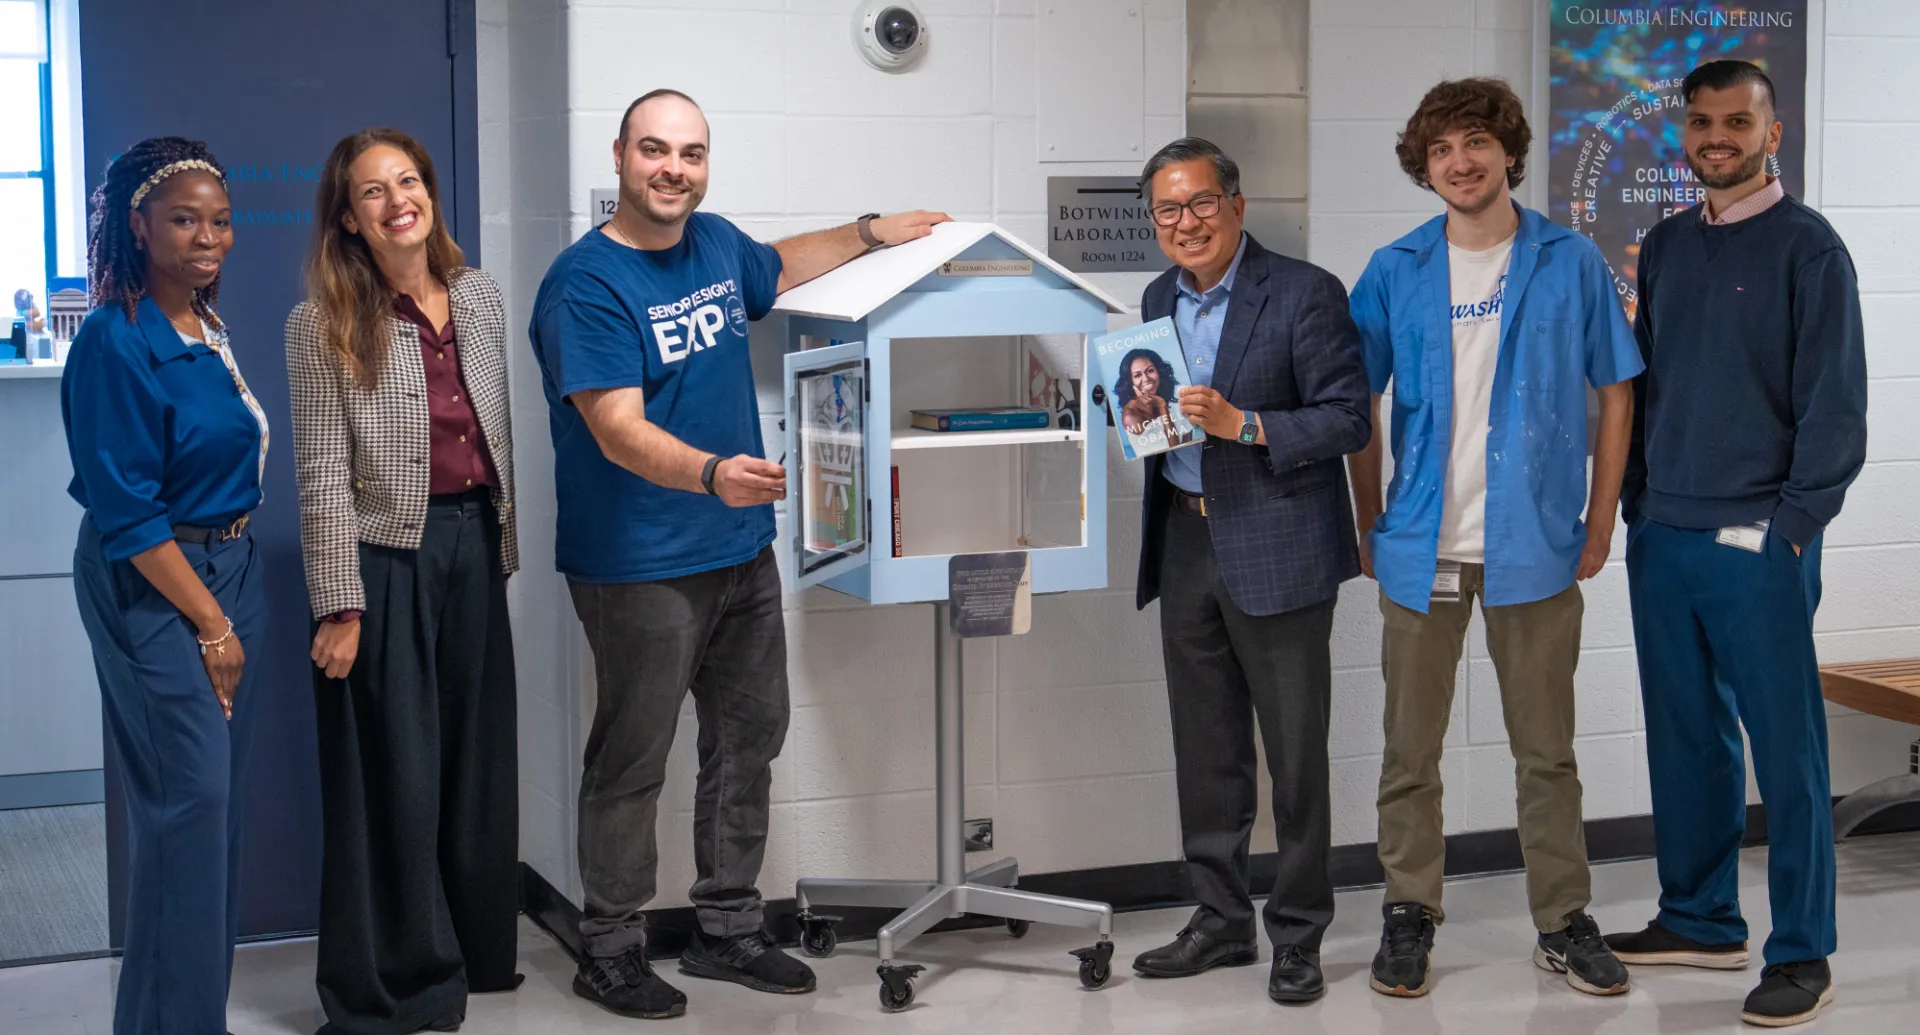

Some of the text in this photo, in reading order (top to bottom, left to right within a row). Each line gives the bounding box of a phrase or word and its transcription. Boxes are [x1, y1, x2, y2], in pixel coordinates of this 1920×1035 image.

[1565, 5, 1793, 28] COLUMBIA ENGINEERING
[1572, 139, 1594, 188] DEVICES
[1596, 91, 1637, 132] ROBOTICS
[1647, 79, 1672, 92] DATA
[1585, 139, 1613, 223] CREATIVE
[600, 200, 620, 215] 12
[987, 264, 1030, 272] ENGINEERING
[1081, 251, 1146, 262] ROOM 1224
[647, 296, 692, 320] SENIOR
[651, 304, 725, 364] EXP
[1098, 326, 1170, 356] BECOMING
[1138, 425, 1189, 446] OBAMA
[894, 519, 902, 546] CHICAGO
